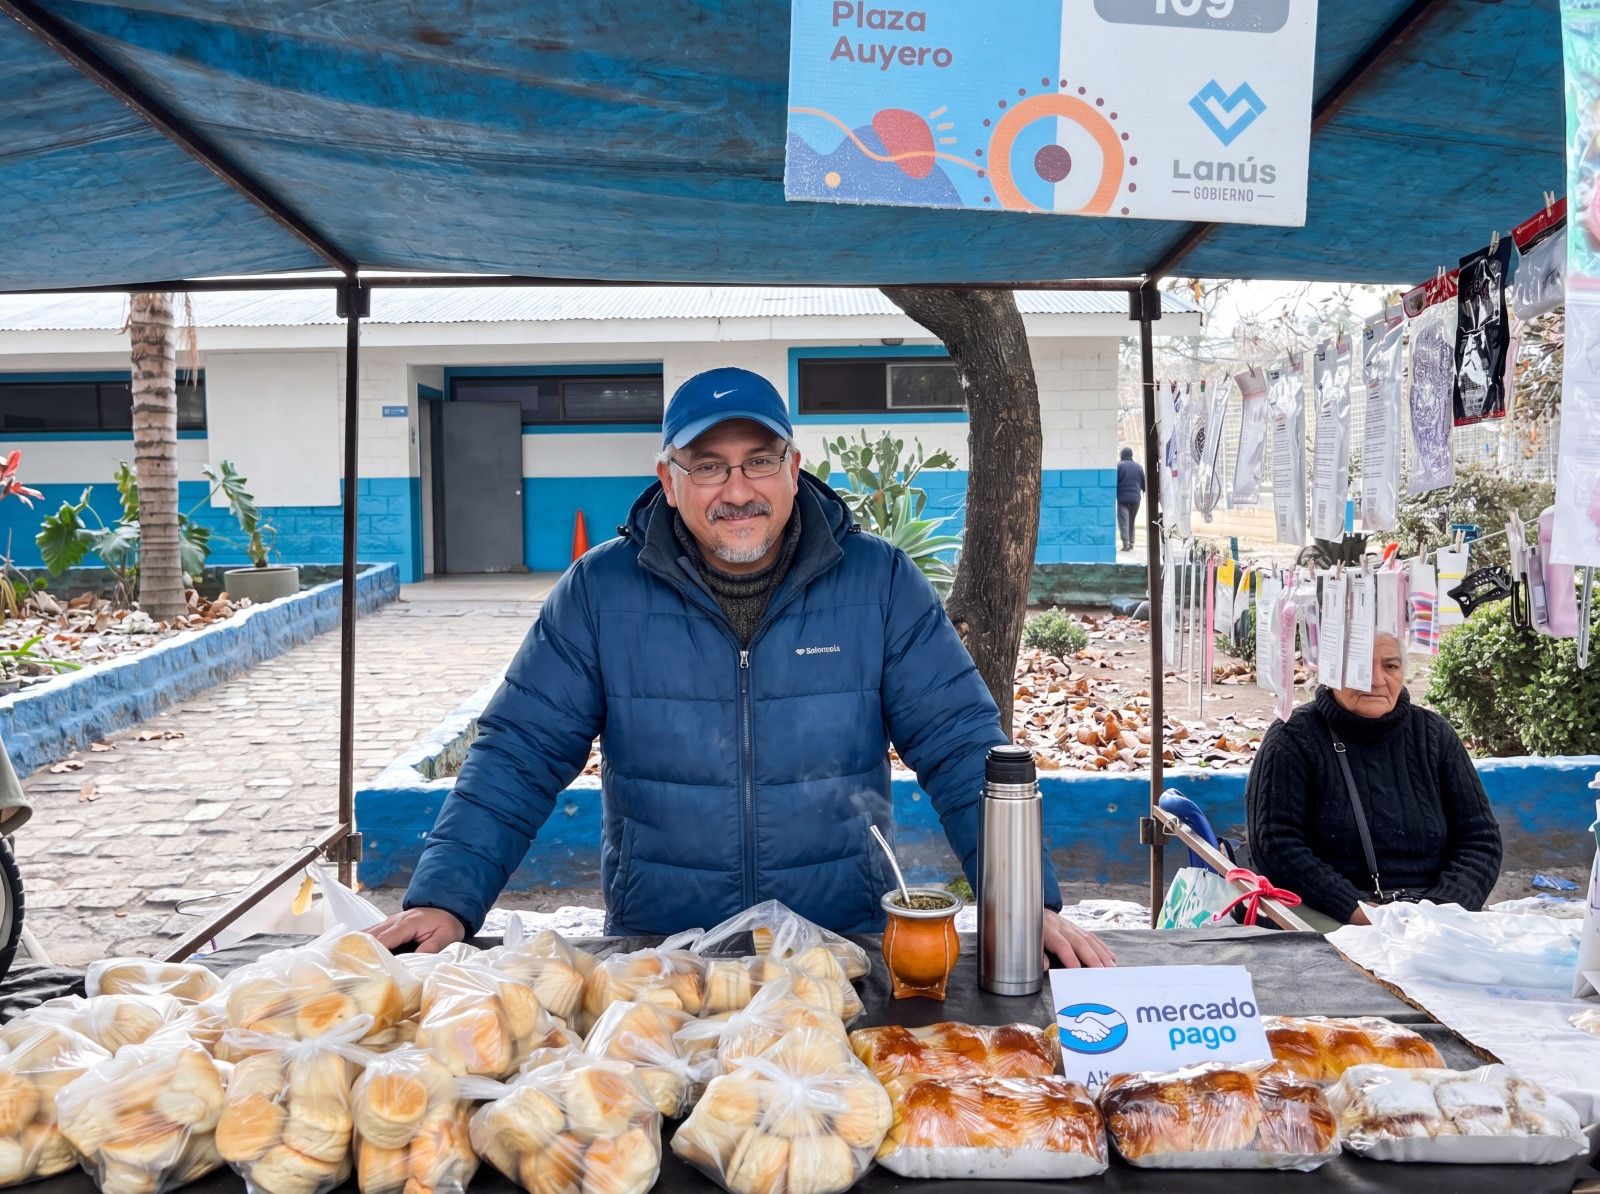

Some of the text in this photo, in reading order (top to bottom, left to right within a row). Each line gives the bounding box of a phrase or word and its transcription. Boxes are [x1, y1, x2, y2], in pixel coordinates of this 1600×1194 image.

[832, 0, 926, 32] Plaza
[830, 35, 953, 71] Auyero
[1173, 156, 1277, 185] Lanús
[1193, 186, 1254, 202] GOBIERNO
[1136, 997, 1256, 1023] mercado
[1168, 1025, 1237, 1051] pago
